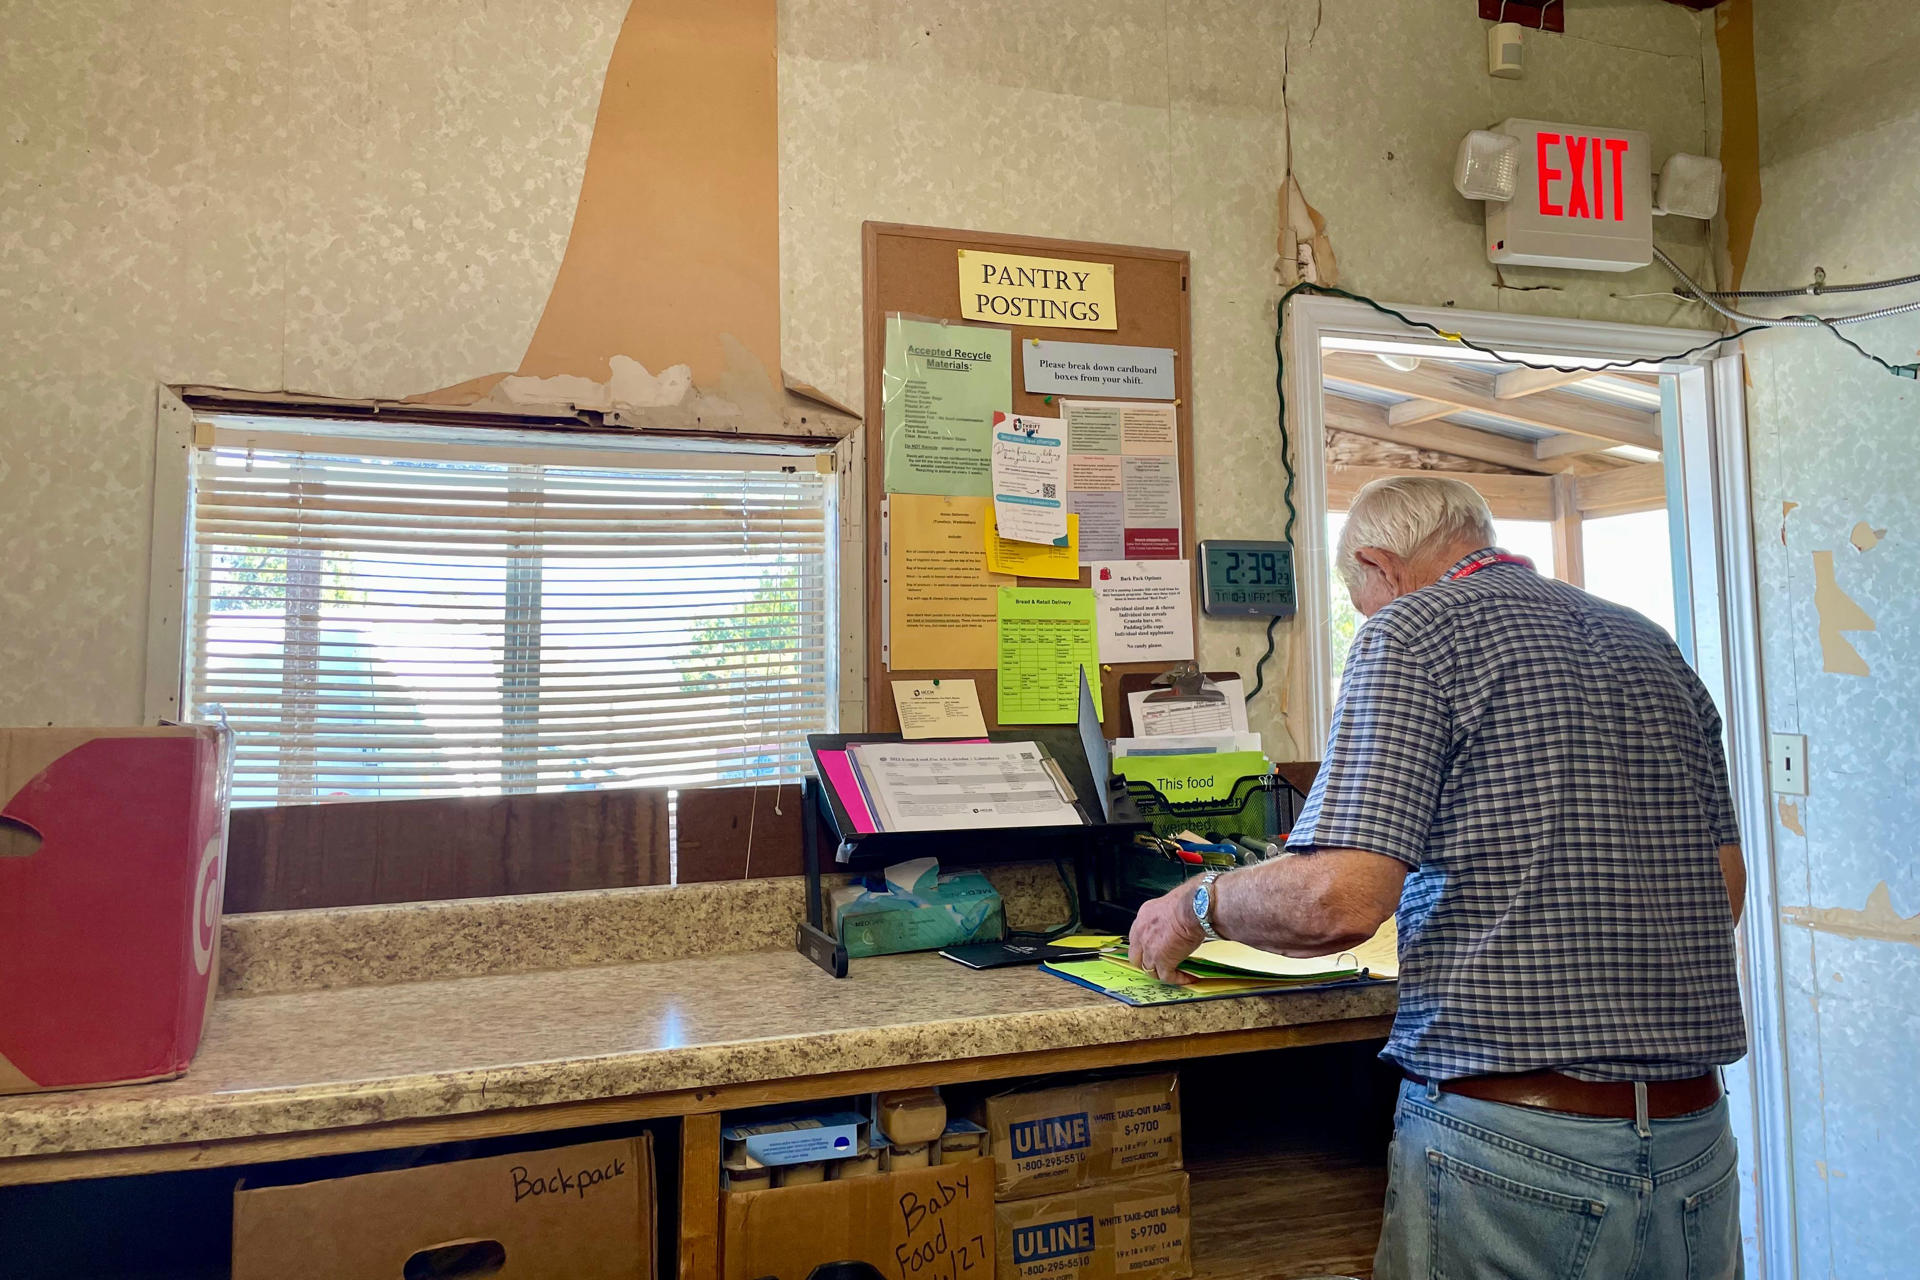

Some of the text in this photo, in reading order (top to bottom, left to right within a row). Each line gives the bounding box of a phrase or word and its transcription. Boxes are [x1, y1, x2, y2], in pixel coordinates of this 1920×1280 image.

[1537, 132, 1629, 221] EXIT
[981, 264, 1091, 291] PANTRY
[975, 293, 1100, 322] POSTINGS
[908, 345, 992, 361] Accepted Recycle
[926, 358, 973, 371] Materials:
[1039, 359, 1157, 375] Please break down cardboard
[1054, 372, 1143, 386] boxes from your shift.
[1226, 552, 1277, 585] 2:39
[1157, 775, 1214, 791] This food
[1094, 1110, 1117, 1123] WHITE
[1117, 1106, 1151, 1120] TAKE-OUT
[1014, 1118, 1086, 1153] ULINE
[1124, 1120, 1159, 1136] S-9700
[1016, 1152, 1086, 1173] 1-800-295-5510
[510, 1158, 625, 1203] Backpack
[899, 1175, 969, 1238] Baby
[1098, 1205, 1181, 1227] WHITE TAKE-OUT BAGS
[1017, 1222, 1090, 1257] ULINE
[1130, 1222, 1167, 1239] S-9700
[896, 1218, 947, 1280] Food
[1018, 1256, 1090, 1277] 1-800-295-5510
